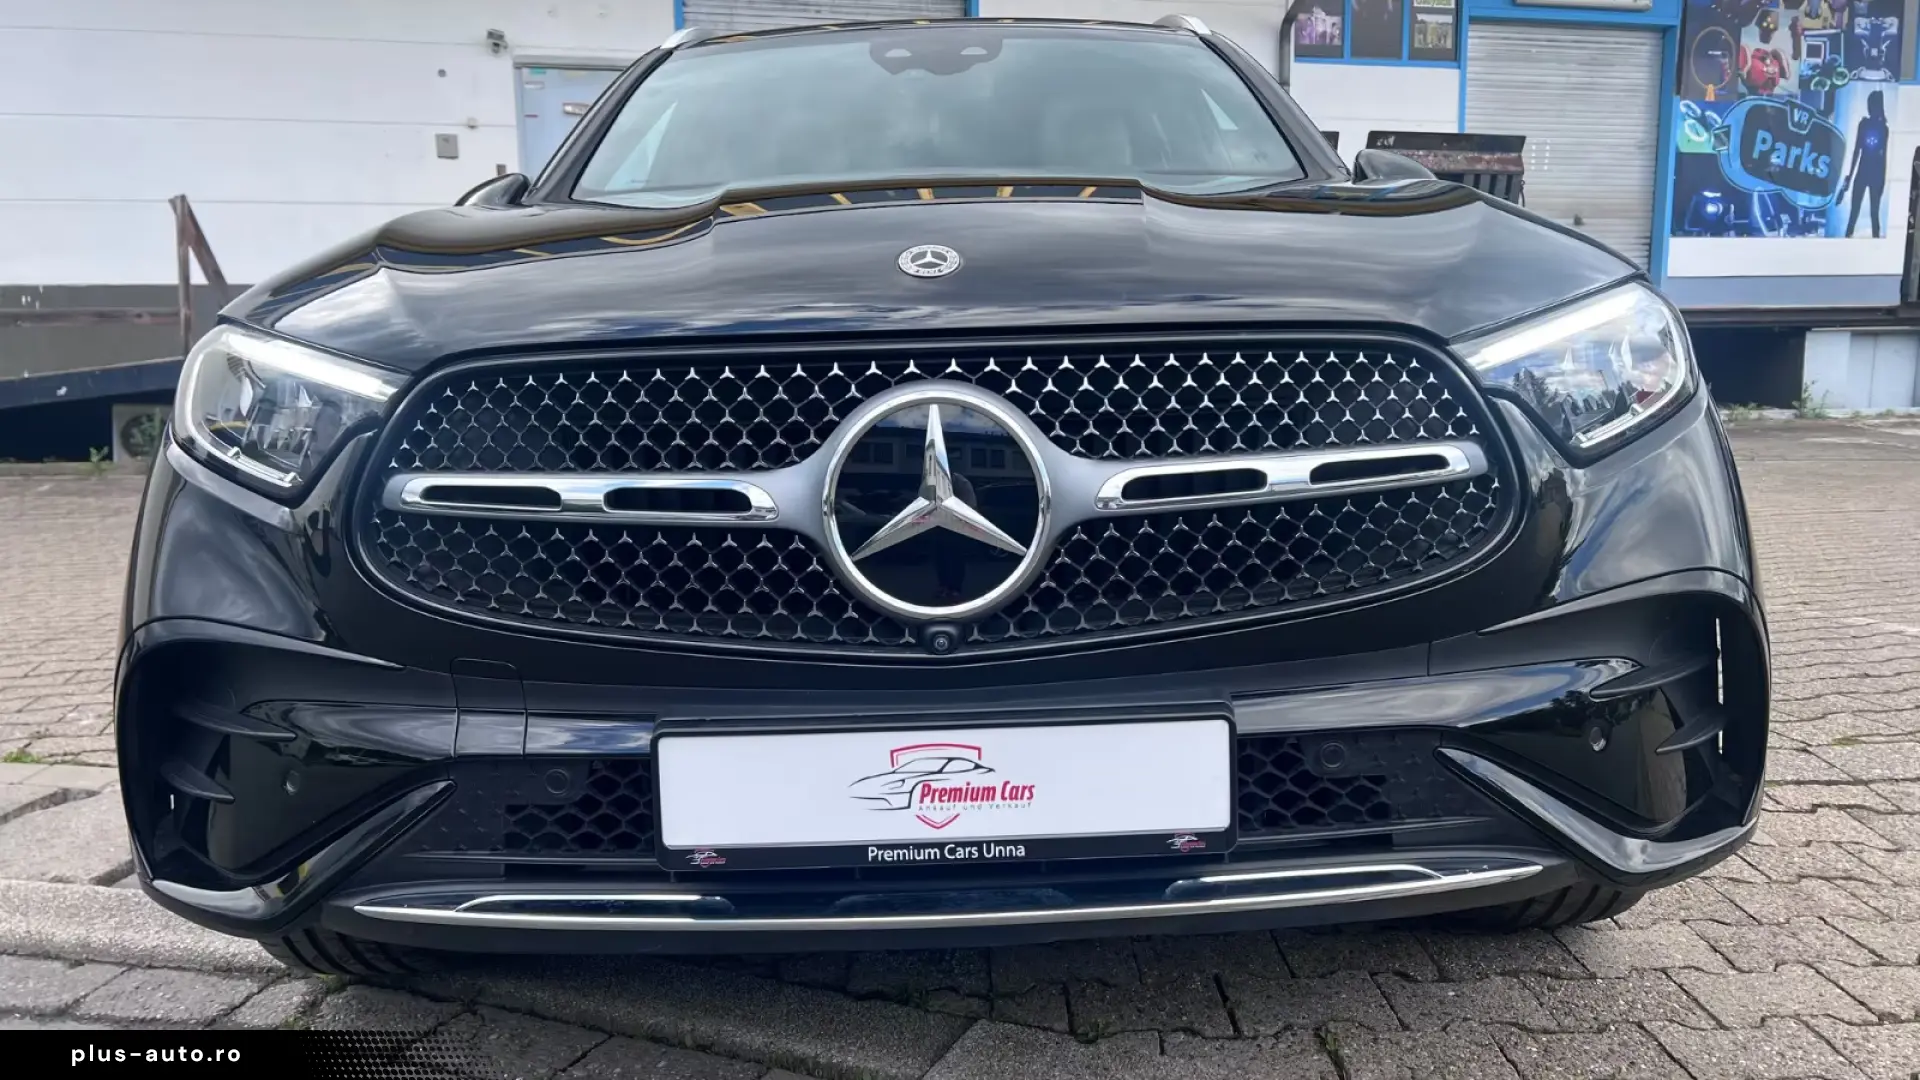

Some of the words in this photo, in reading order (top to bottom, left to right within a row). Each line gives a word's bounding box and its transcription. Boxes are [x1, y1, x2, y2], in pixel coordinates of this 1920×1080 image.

[1793, 107, 1810, 125] VR
[1752, 128, 1831, 178] Parks
[919, 781, 997, 804] Premium
[1000, 780, 1036, 801] Cars
[918, 803, 957, 812] Ankauf
[963, 803, 982, 811] und
[988, 801, 1032, 810] Verkauf
[868, 846, 941, 862] Premium
[943, 844, 979, 859] Cars
[982, 842, 1026, 858] Unna
